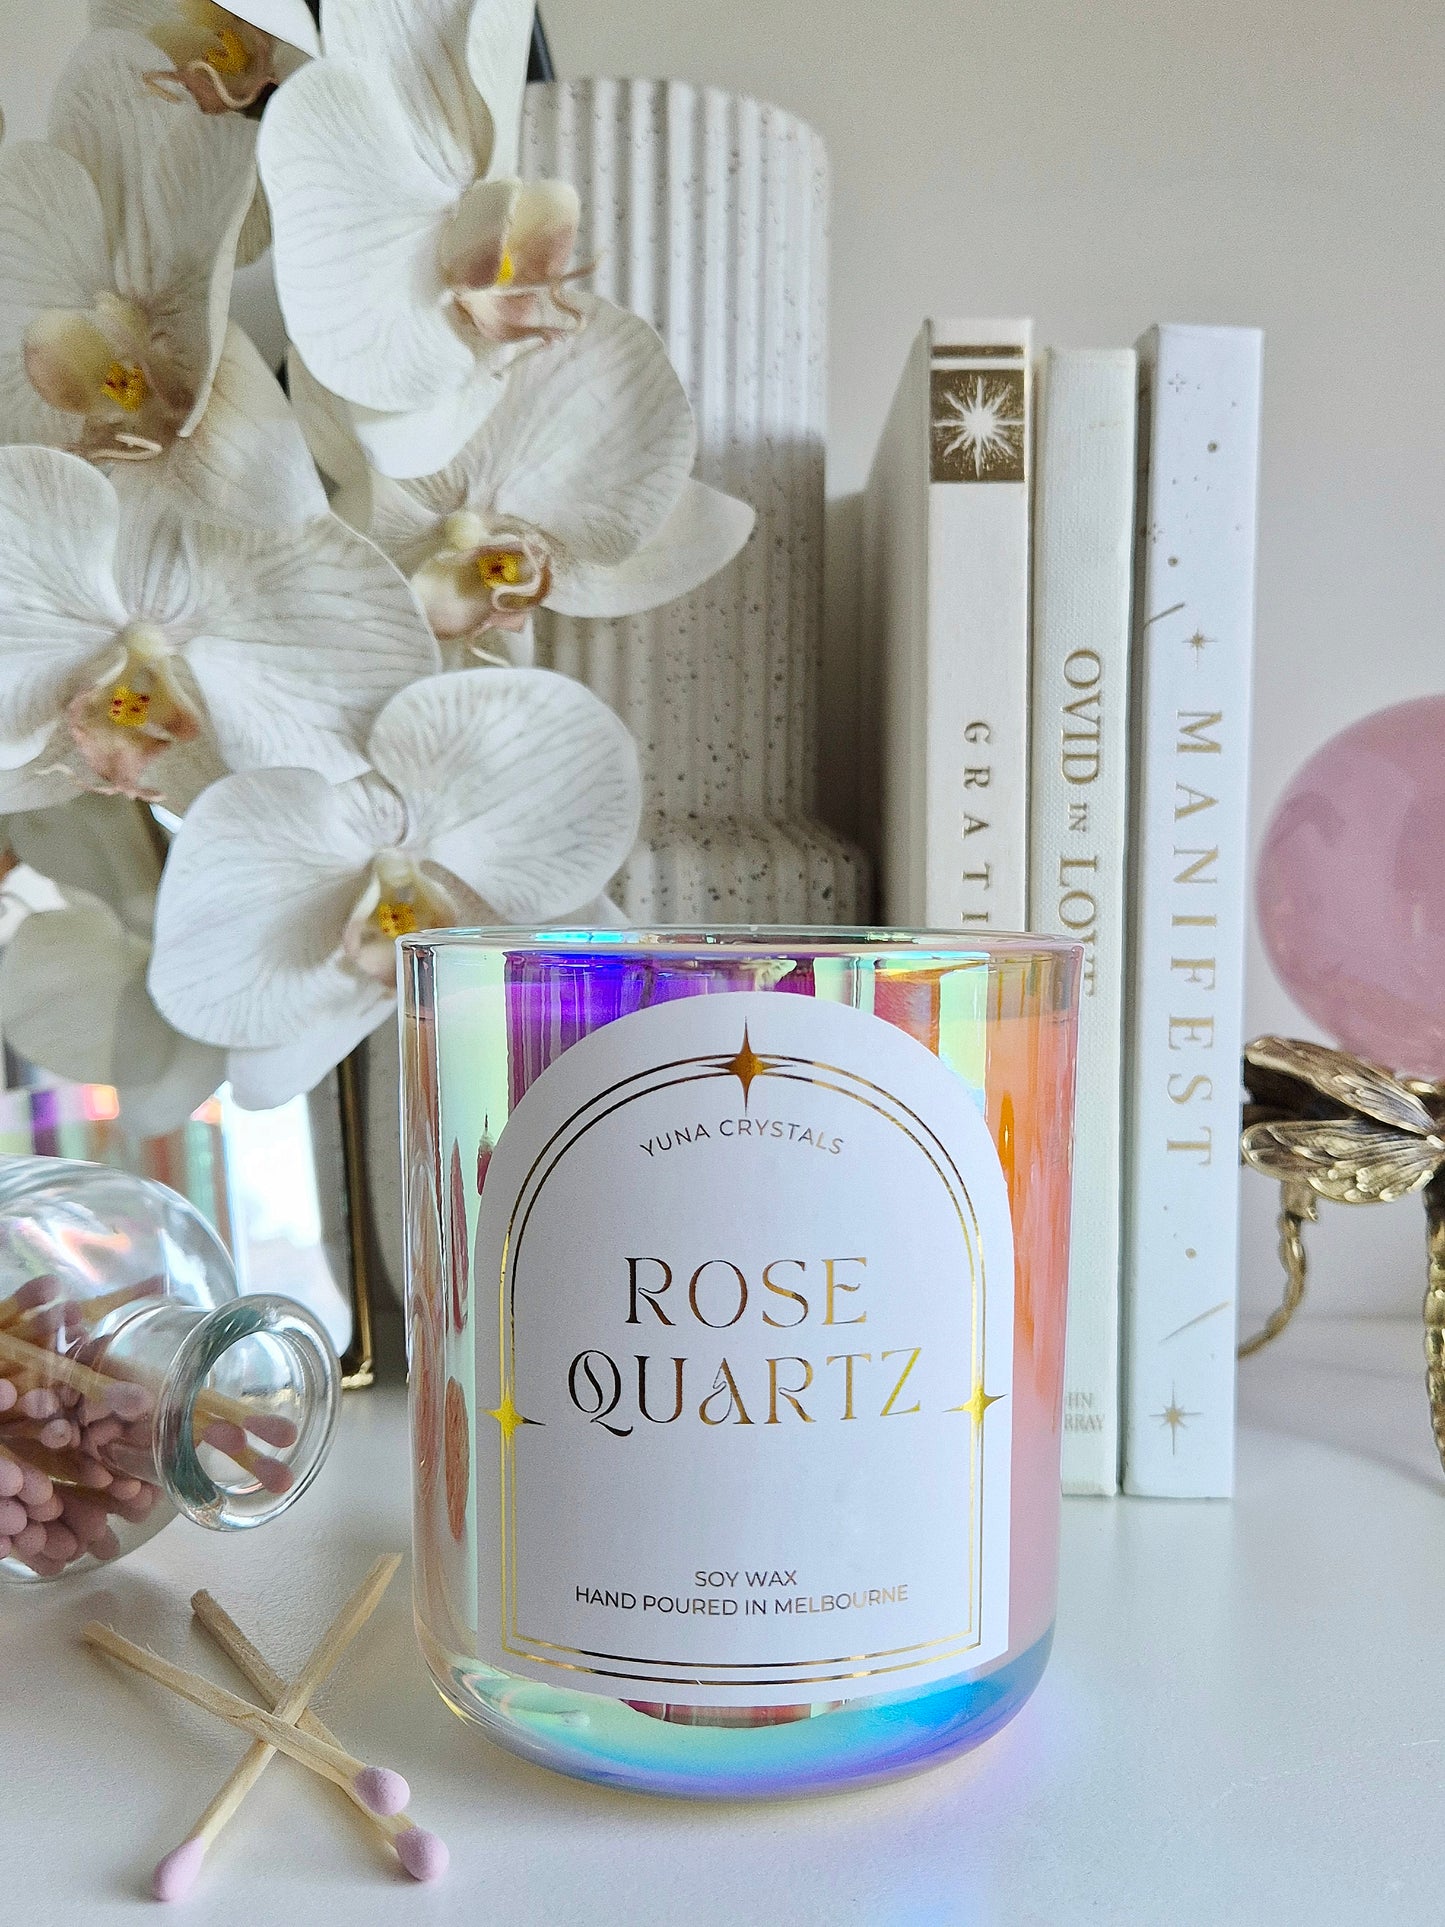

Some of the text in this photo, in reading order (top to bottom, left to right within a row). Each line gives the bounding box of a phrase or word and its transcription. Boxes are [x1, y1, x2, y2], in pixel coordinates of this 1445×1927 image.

[1060, 649, 1102, 785] OVID
[1067, 801, 1088, 832] IN
[1166, 709, 1223, 1166] MANIFEST
[640, 1118, 844, 1157] YUNA CRYSTALS
[624, 1256, 867, 1328] ROSE
[567, 1347, 922, 1437] QUARTZ
[575, 1584, 909, 1616] HAND POURED IN MELBOURNE
[694, 1570, 798, 1588] SOY WAX
